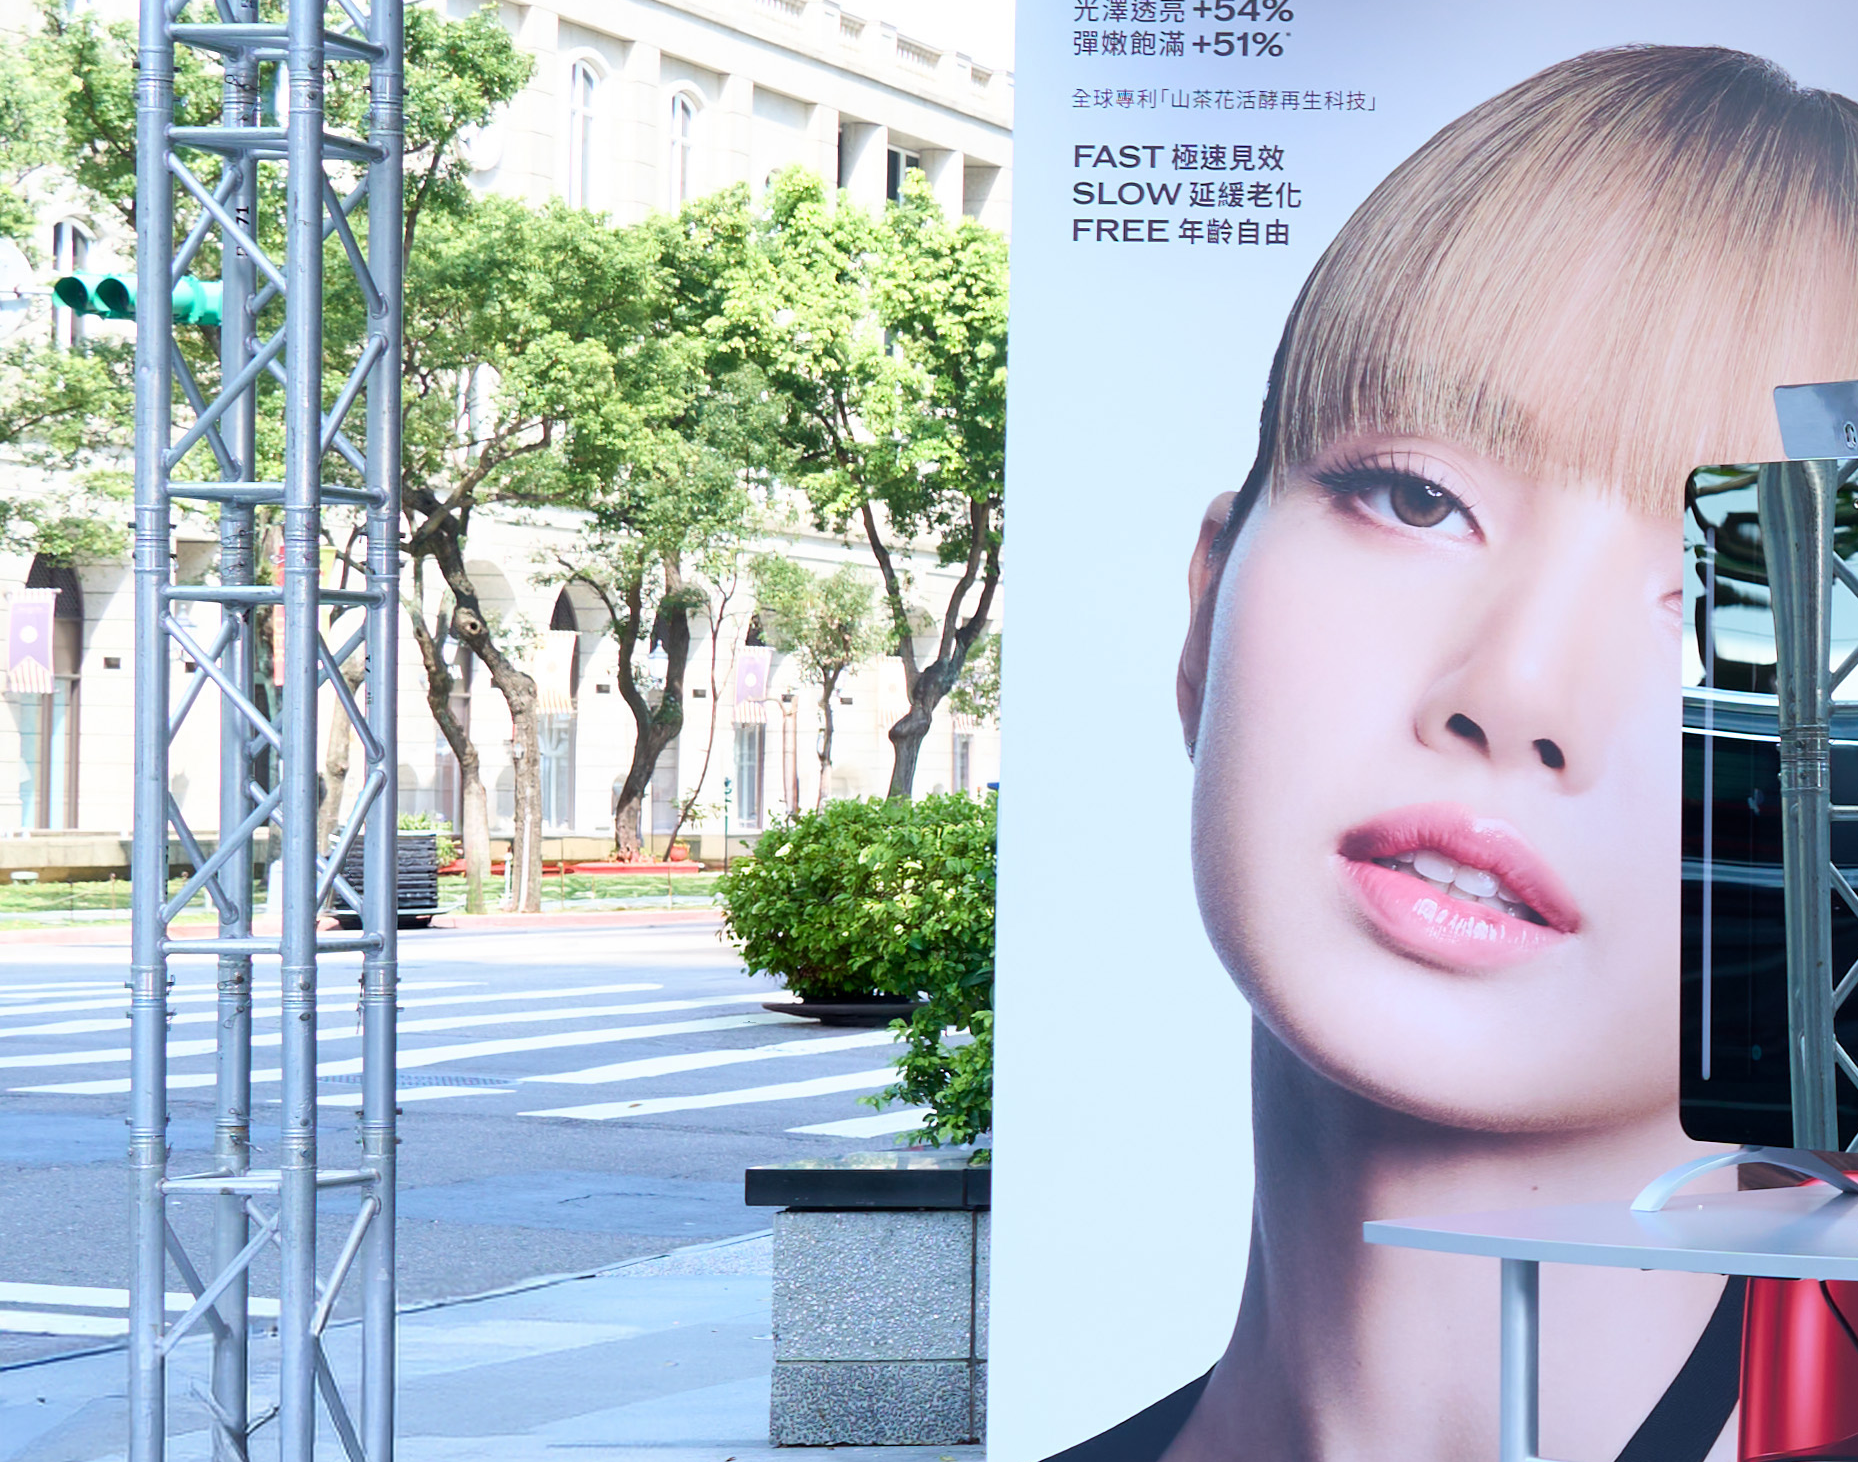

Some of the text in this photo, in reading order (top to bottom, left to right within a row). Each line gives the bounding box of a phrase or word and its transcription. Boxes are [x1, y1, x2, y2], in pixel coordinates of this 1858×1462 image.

[1073, 30, 1186, 58] 彈嫩飽滿
[1073, 144, 1285, 172] FAST 極速見效
[1072, 181, 1302, 209] SLOW 延緩老化
[1072, 218, 1290, 246] FREE 年齡自由
